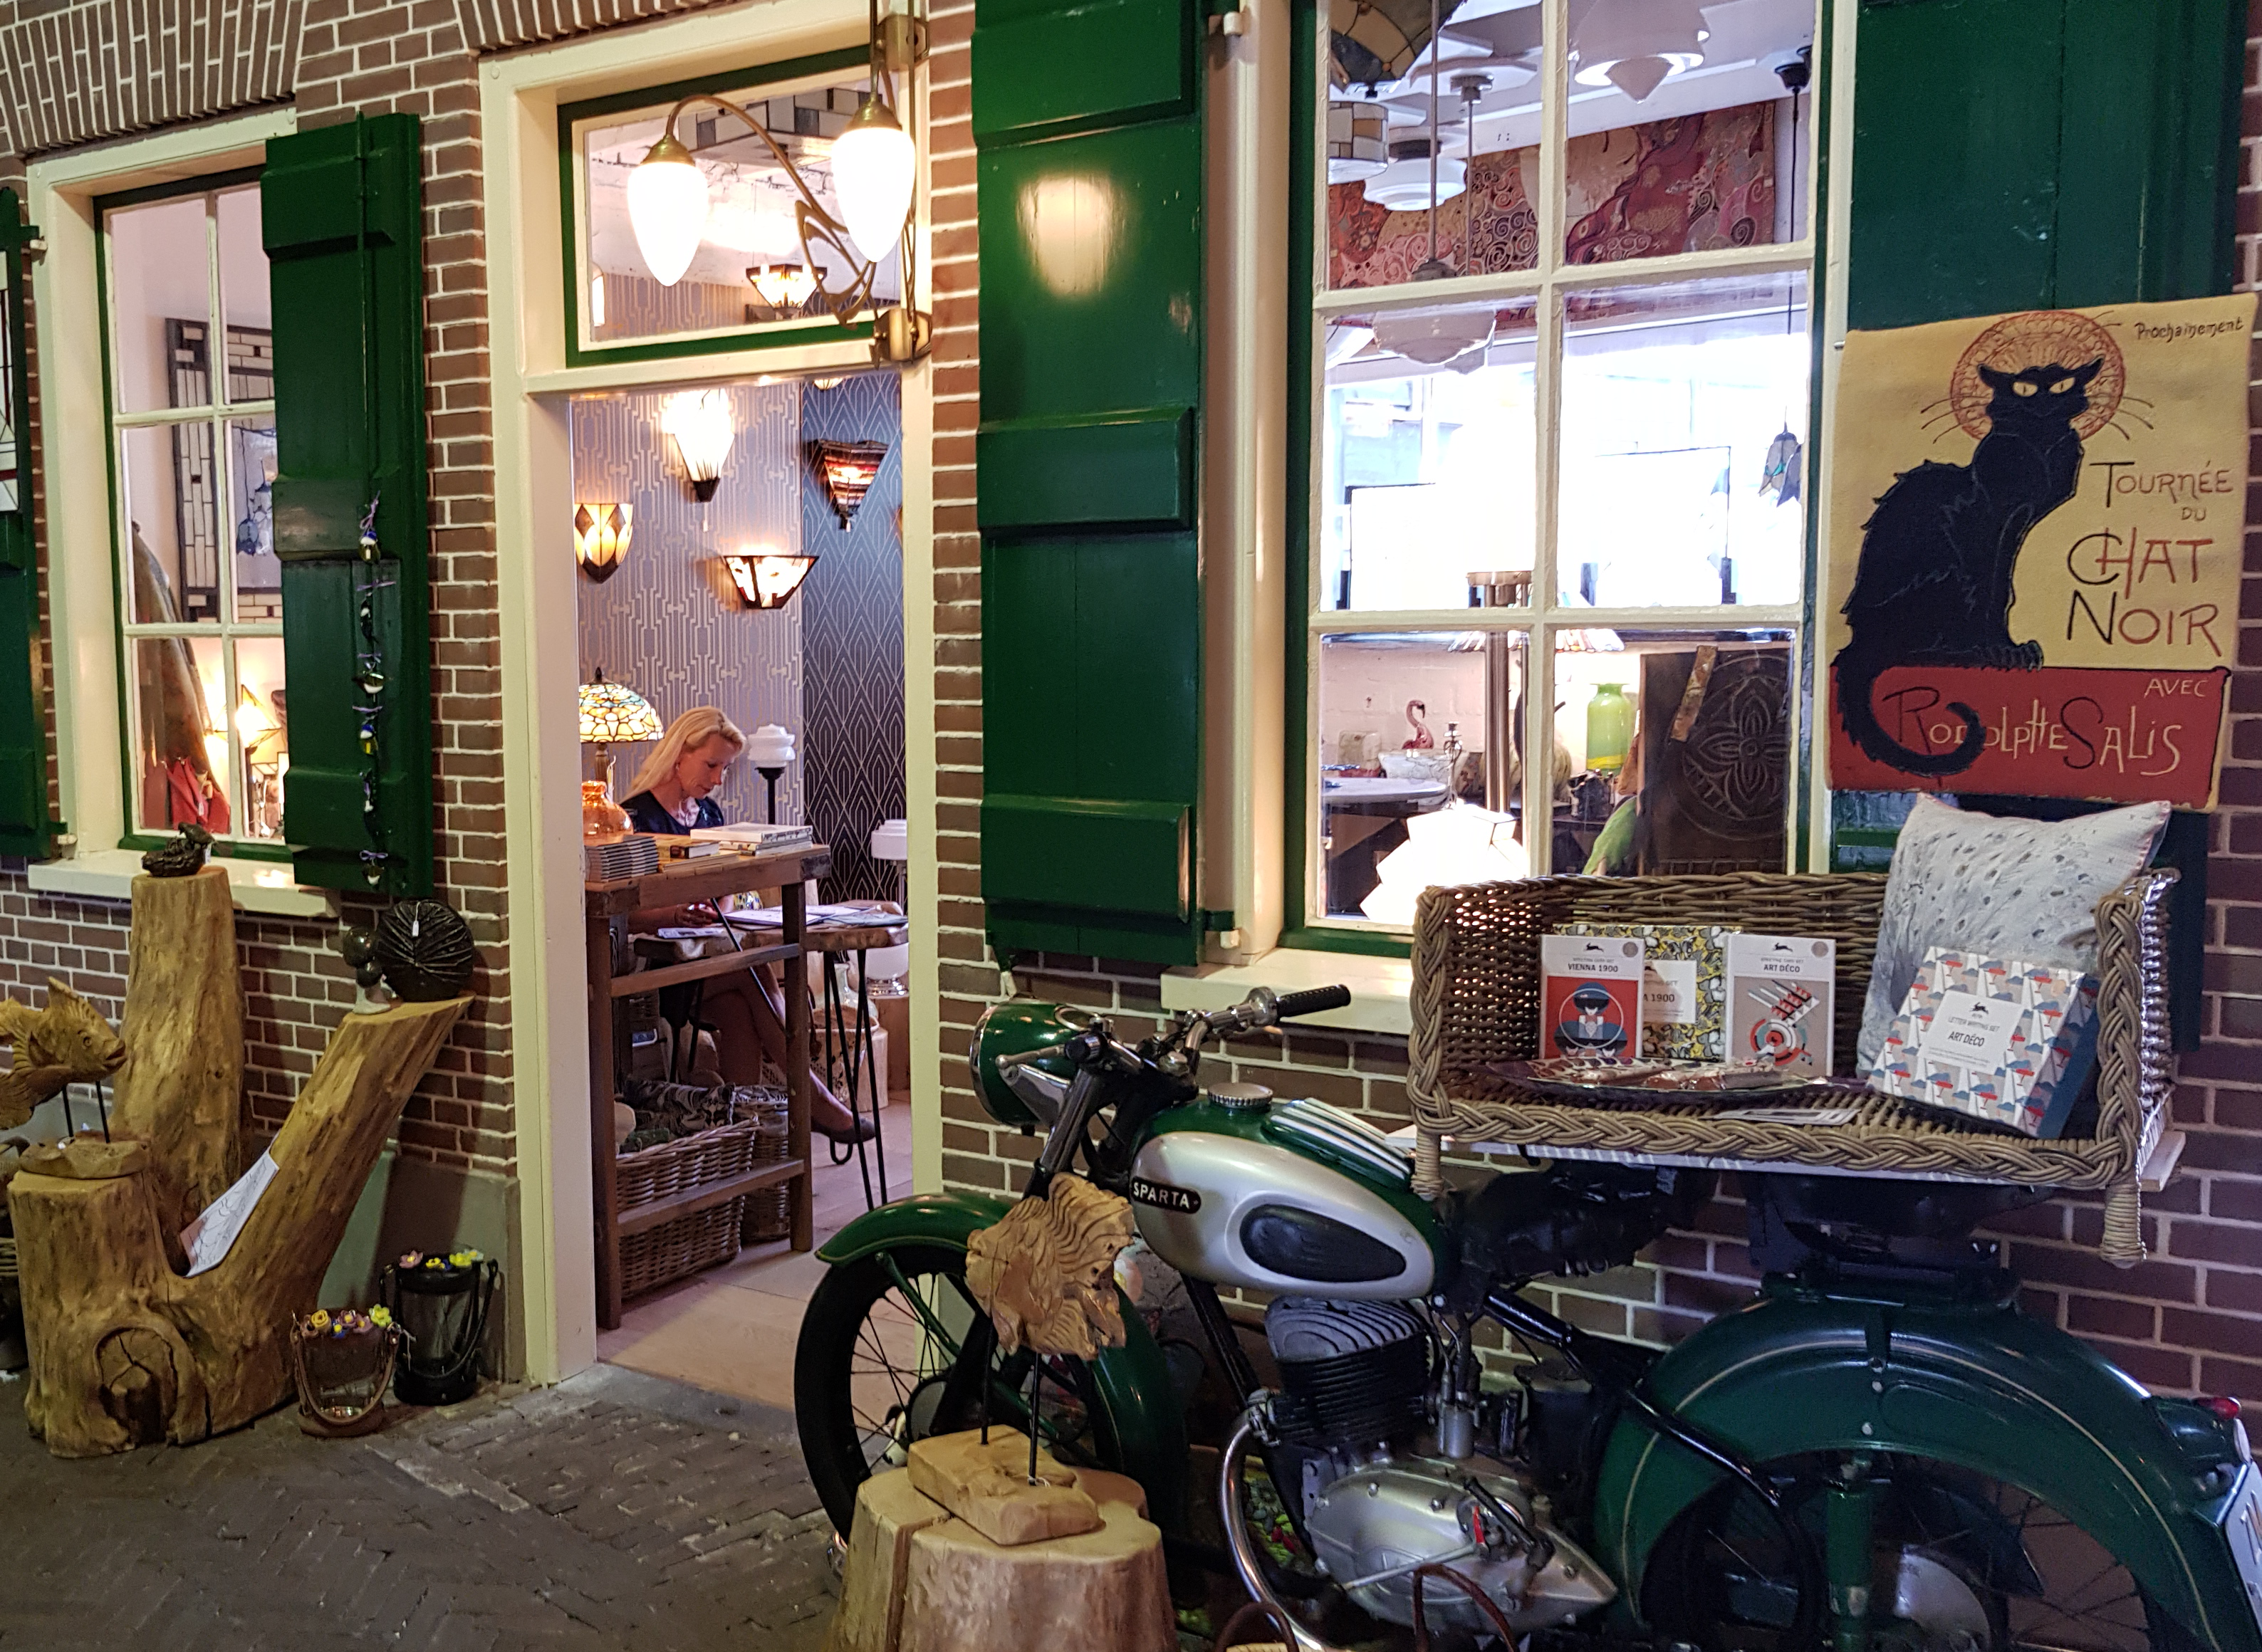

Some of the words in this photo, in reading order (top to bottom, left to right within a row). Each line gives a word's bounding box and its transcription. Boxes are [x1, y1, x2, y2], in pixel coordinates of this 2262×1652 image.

[2135, 318, 2244, 342] Prochainement
[2090, 460, 2234, 508] TOURNÉE
[2181, 510, 2206, 521] DU
[2068, 528, 2213, 599] CHAT
[2067, 590, 2222, 657] NOIR
[2144, 679, 2206, 697] AVEC
[2060, 697, 2182, 776] SALIS
[1652, 993, 1675, 1003] 1900
[1948, 1031, 1964, 1042] ART
[1964, 1034, 1985, 1047] DÉCO
[1133, 1182, 1189, 1208] SPARTA
